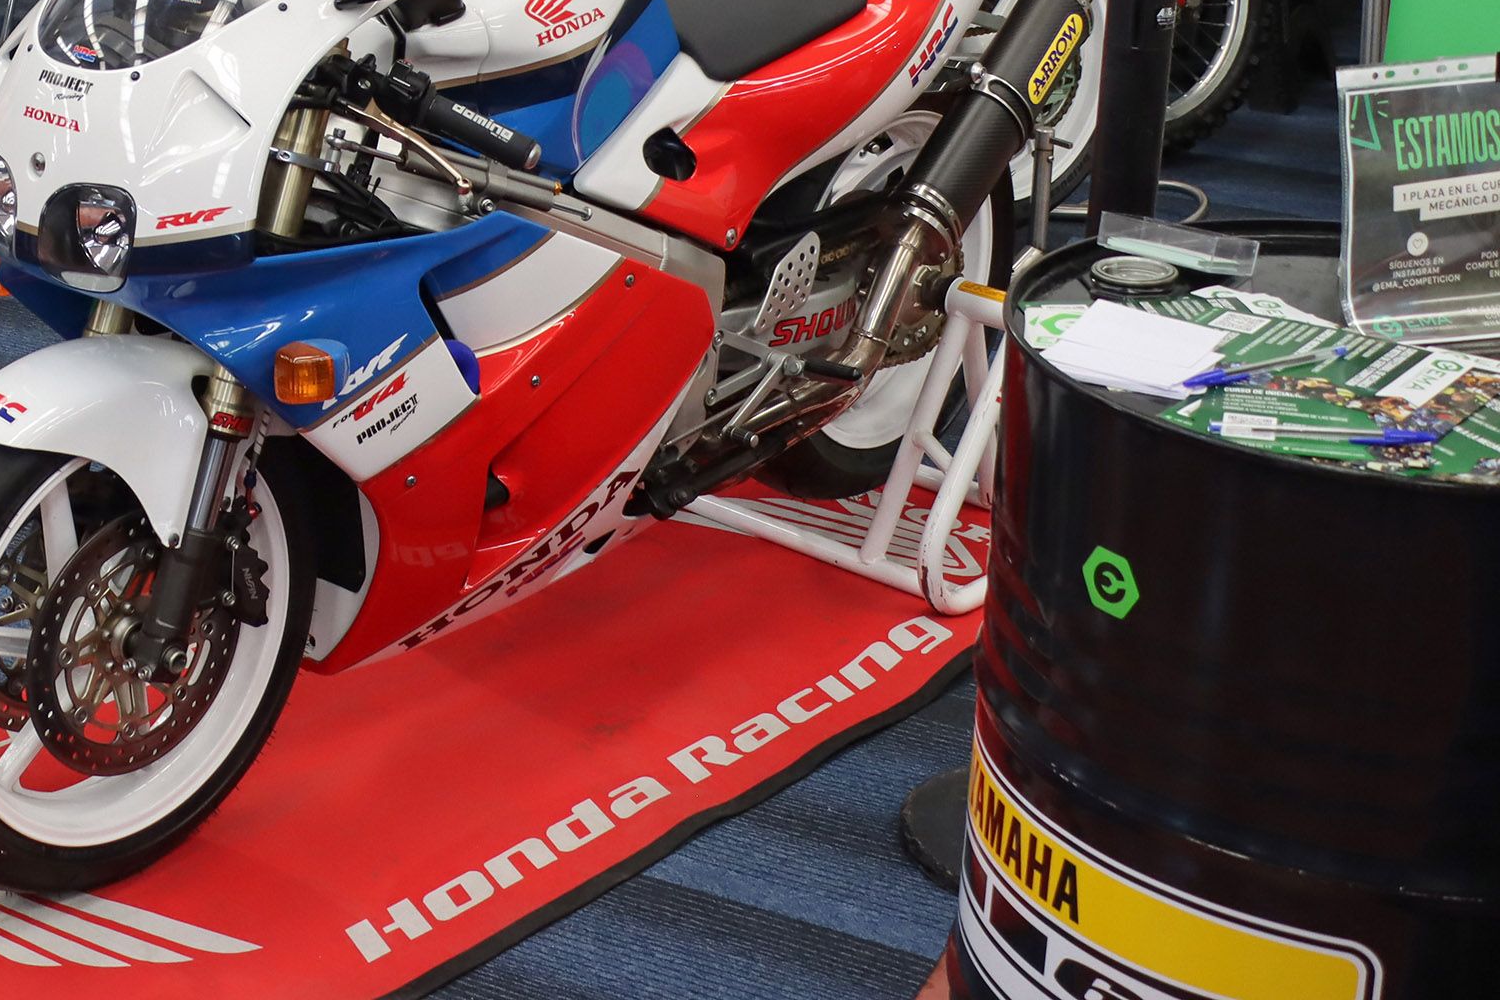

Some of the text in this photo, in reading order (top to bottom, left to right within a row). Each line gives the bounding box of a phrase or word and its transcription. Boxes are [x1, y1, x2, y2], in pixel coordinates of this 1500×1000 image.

[536, 7, 606, 47] HONDA
[73, 44, 99, 63] HRC
[908, 2, 959, 88] HRC
[1033, 17, 1078, 98] ARROW
[38, 69, 94, 95] PROJECT
[23, 105, 81, 133] HONDA
[452, 103, 514, 142] domino
[1410, 187, 1445, 201] PLAZA
[1449, 185, 1463, 195] EN
[1466, 183, 1478, 193] EL
[1428, 195, 1488, 212] MECÁNICA
[155, 206, 233, 230] RVF
[1389, 256, 1445, 270] SÍGUENOS EN
[1392, 266, 1440, 279] INSTAGRAM
[356, 393, 418, 445] PROJECT
[398, 468, 641, 652] HONDA
[345, 615, 953, 963] Honda Racing
[970, 757, 1080, 926] YAMAHA
